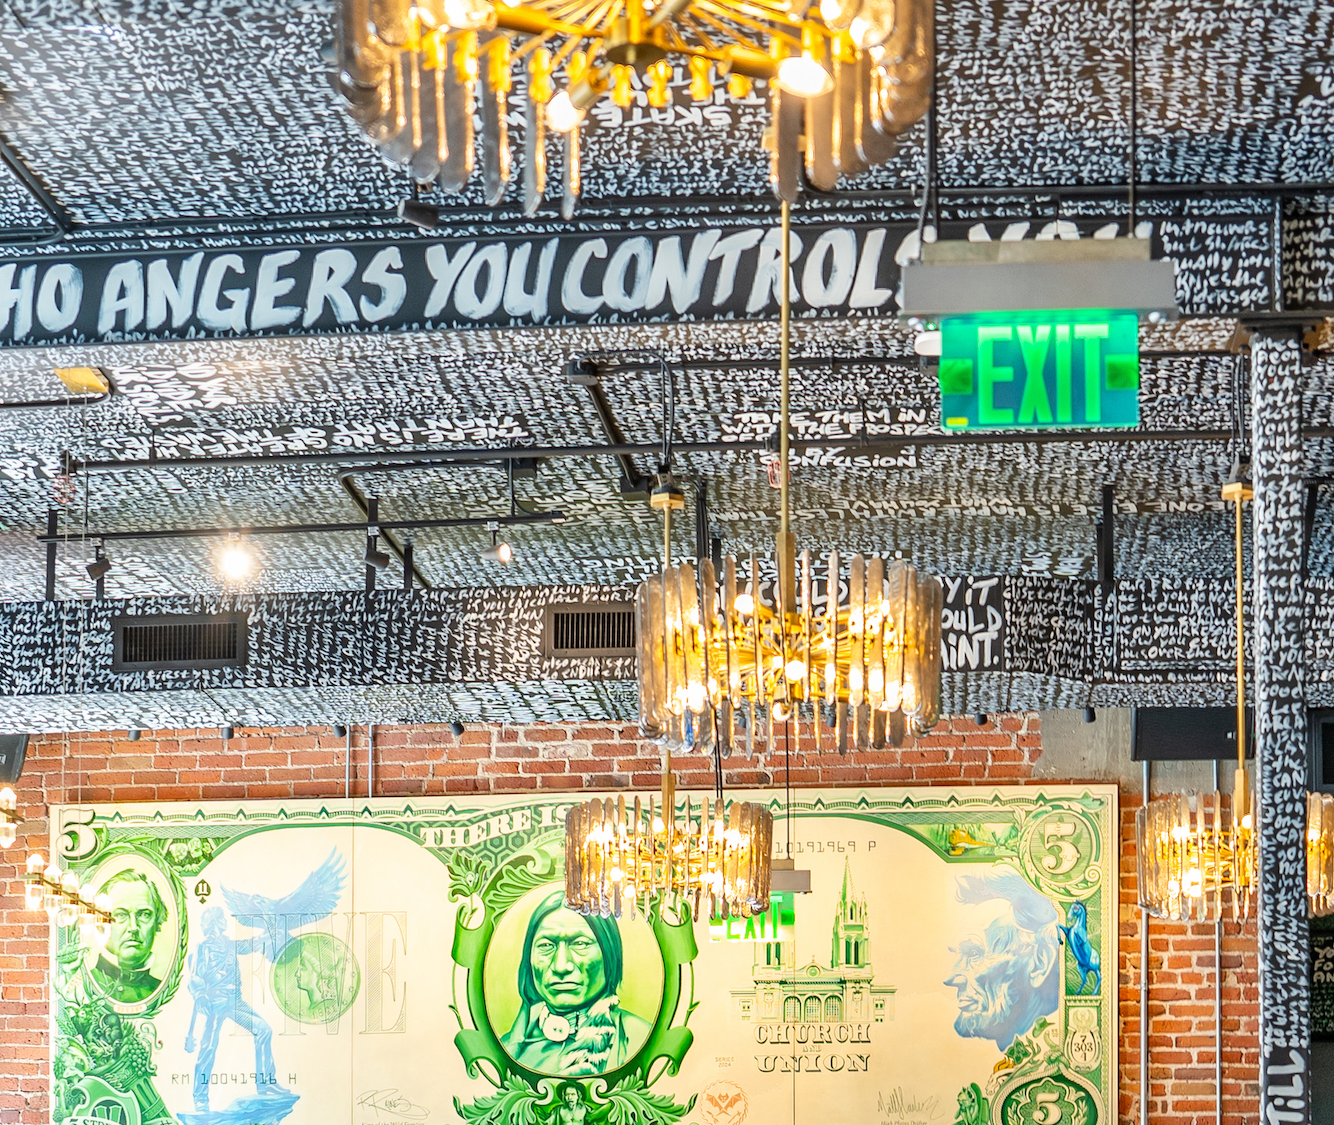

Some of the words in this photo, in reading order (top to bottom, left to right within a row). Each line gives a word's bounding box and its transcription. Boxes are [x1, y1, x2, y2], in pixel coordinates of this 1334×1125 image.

[98, 246, 409, 338] ANGERS
[426, 233, 559, 319] YOU
[977, 324, 1109, 425] EXIT
[417, 424, 528, 443] THERE
[57, 809, 98, 861] 5
[419, 805, 532, 849] THERE
[1042, 822, 1080, 874] 5
[230, 911, 407, 1036] FIVE
[754, 1023, 871, 1045] CHURCH
[754, 1053, 871, 1073] UNION
